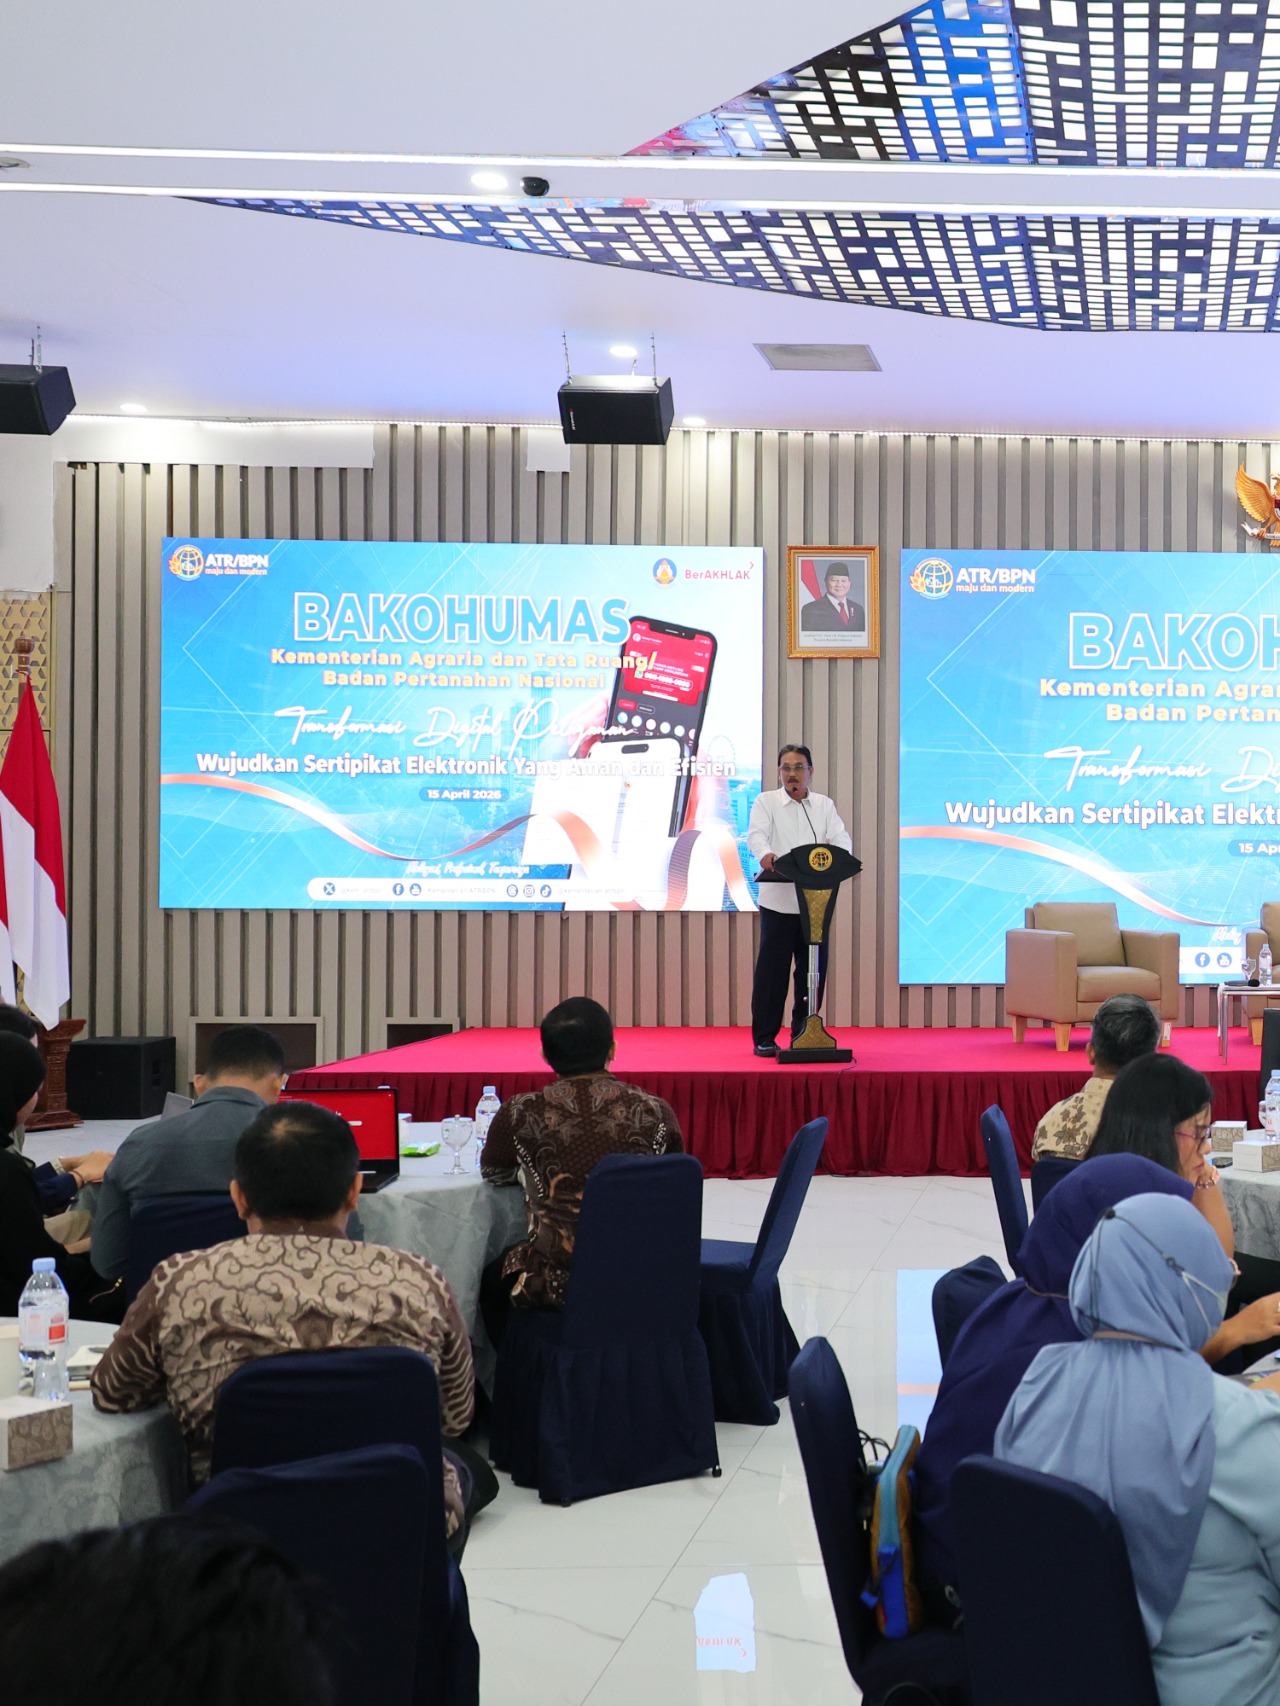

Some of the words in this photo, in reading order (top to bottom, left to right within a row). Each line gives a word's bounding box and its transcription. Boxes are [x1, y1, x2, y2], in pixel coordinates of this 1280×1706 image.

[205, 553, 269, 568] ATR/BPN
[205, 567, 224, 576] maju
[224, 568, 238, 576] dan
[240, 568, 268, 576] modern
[684, 568, 751, 581] BerAKHLAK
[956, 568, 1036, 584] ATR/BPN
[956, 584, 979, 594] maju
[980, 584, 998, 593] dan
[998, 584, 1035, 593] modern
[293, 591, 632, 646] BAKOHUMAS
[270, 648, 402, 666] Kementerian
[408, 650, 484, 670] Agraria
[490, 652, 530, 668] dan
[535, 652, 578, 668] Tata
[323, 671, 388, 686] Badan
[394, 671, 515, 688] Pertanahan
[518, 673, 605, 688] Nasional
[1040, 678, 1206, 698] Kementerian
[1106, 704, 1187, 721] Badan
[274, 705, 408, 746] Transformasi
[413, 706, 505, 753] Digital
[196, 751, 298, 777] Wujudkan
[304, 752, 402, 778] Sertipikat
[406, 755, 508, 776] Elektronik
[514, 758, 561, 780] Yang
[568, 758, 624, 776] Aman
[625, 758, 664, 777] dan
[670, 756, 736, 778] Efisien
[1044, 744, 1212, 792] Transformasi
[426, 789, 440, 800] 15
[441, 789, 470, 802] April
[472, 790, 502, 800] 2026
[944, 798, 1075, 828] Wujudkan
[1080, 800, 1206, 830] Sertipikat
[1238, 842, 1255, 854] 15
